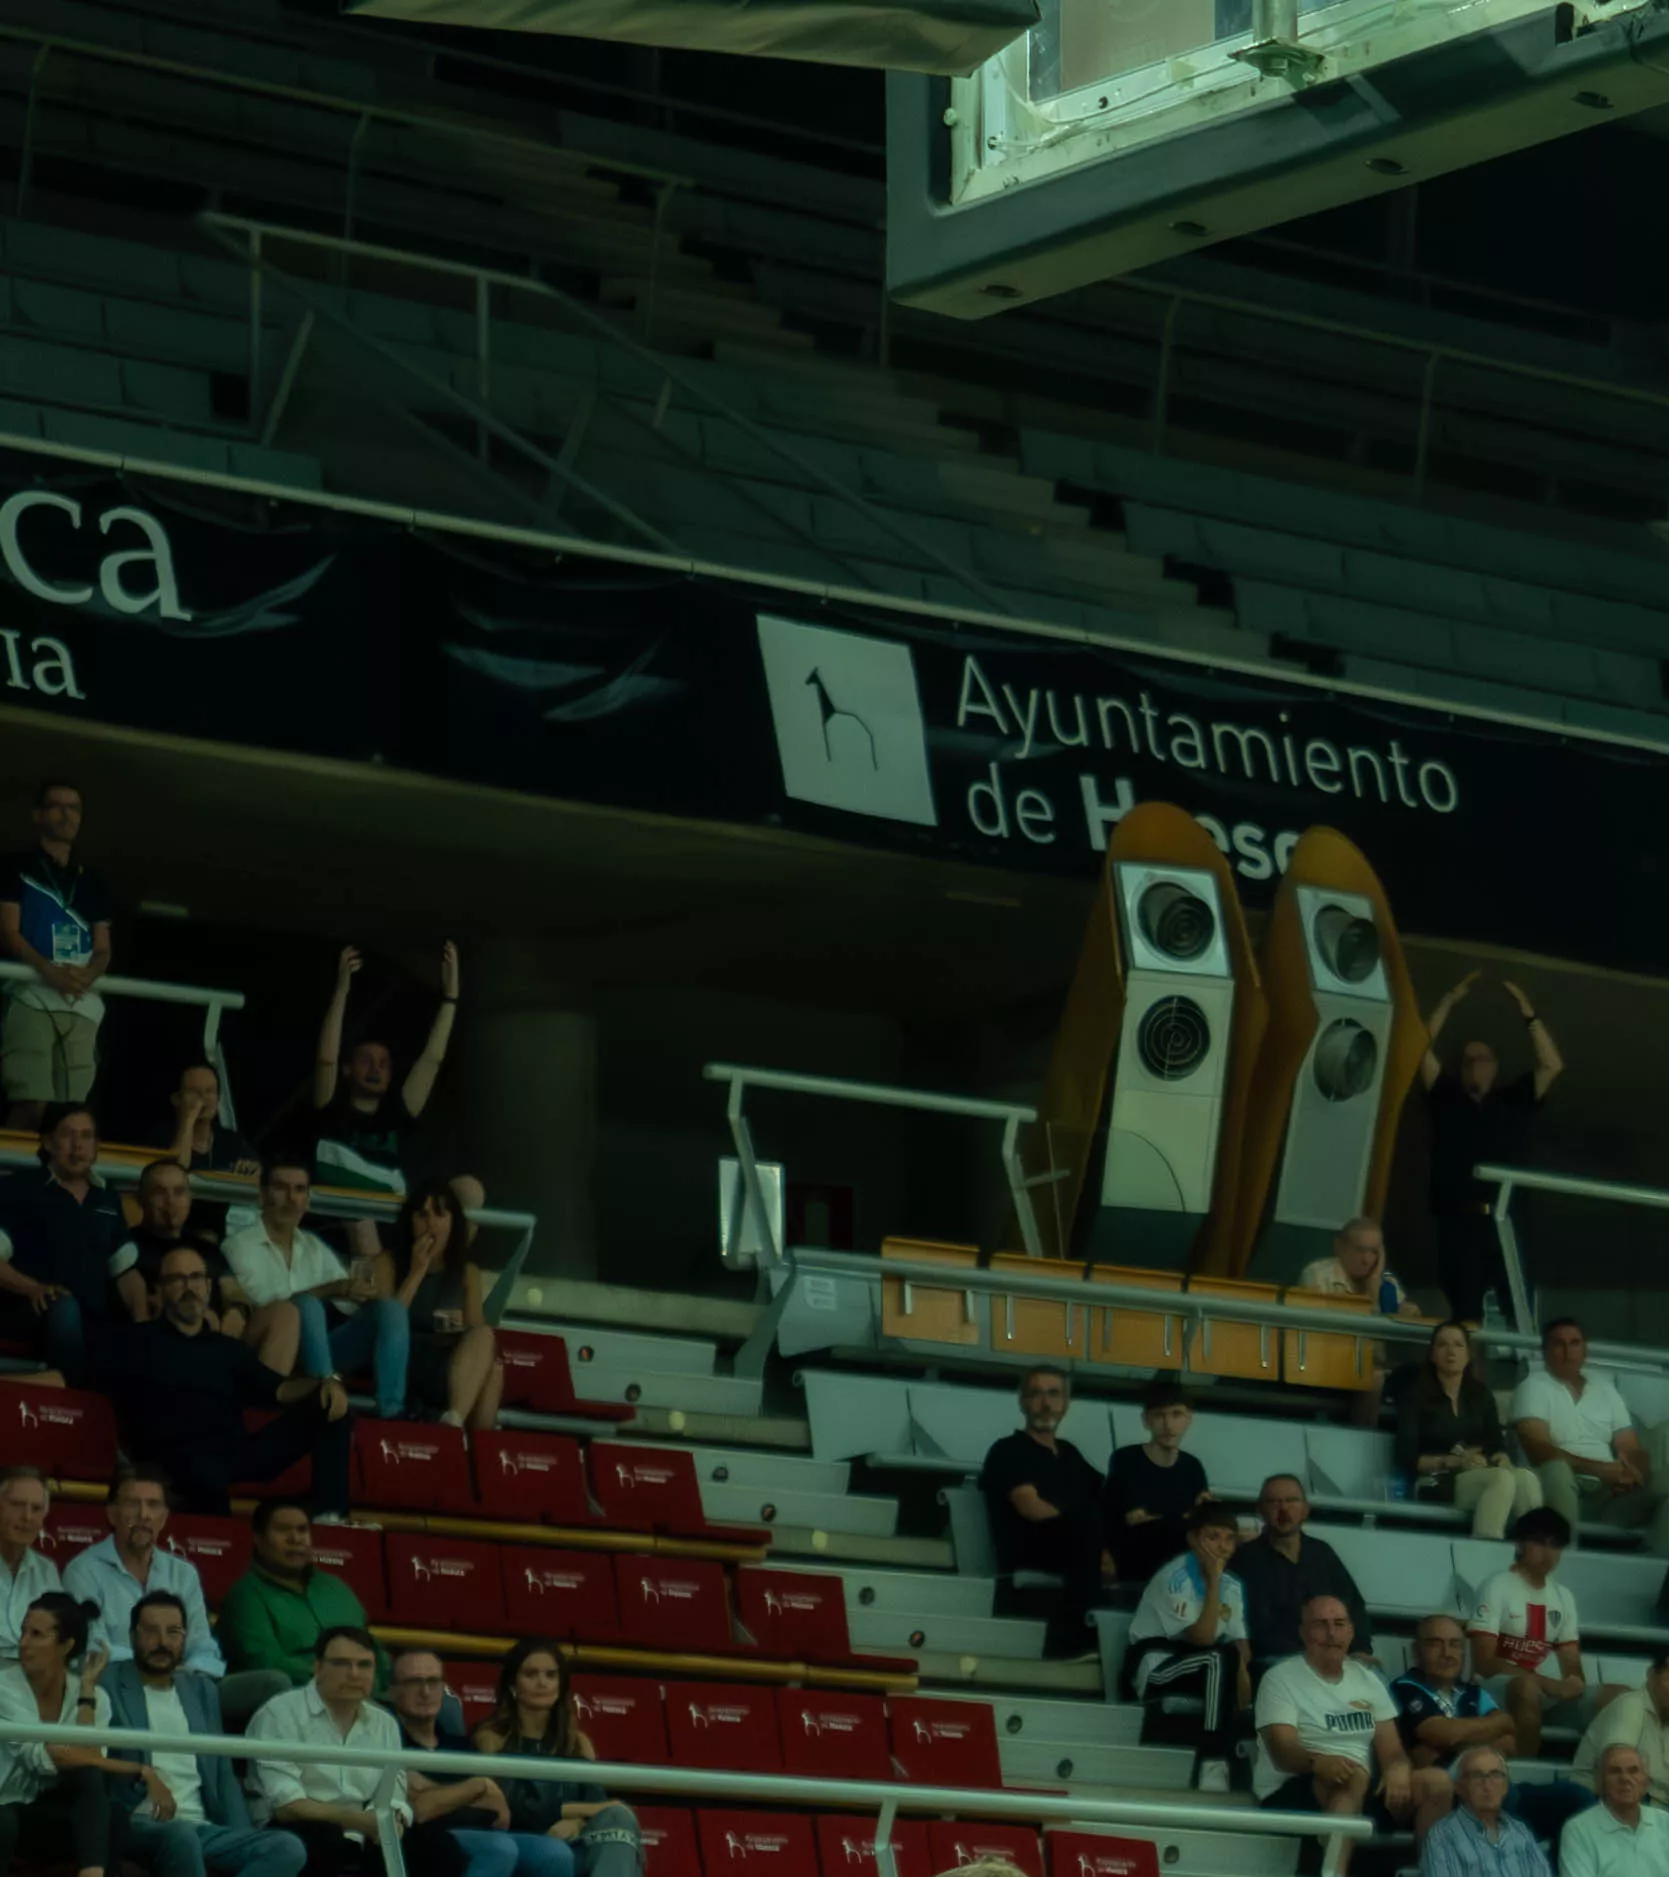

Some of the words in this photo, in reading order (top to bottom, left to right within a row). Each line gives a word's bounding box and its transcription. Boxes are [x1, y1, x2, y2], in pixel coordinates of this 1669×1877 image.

[956, 655, 1459, 814] Ayuntamiento
[966, 762, 1055, 845] de
[1324, 1711, 1374, 1732] PUMA
